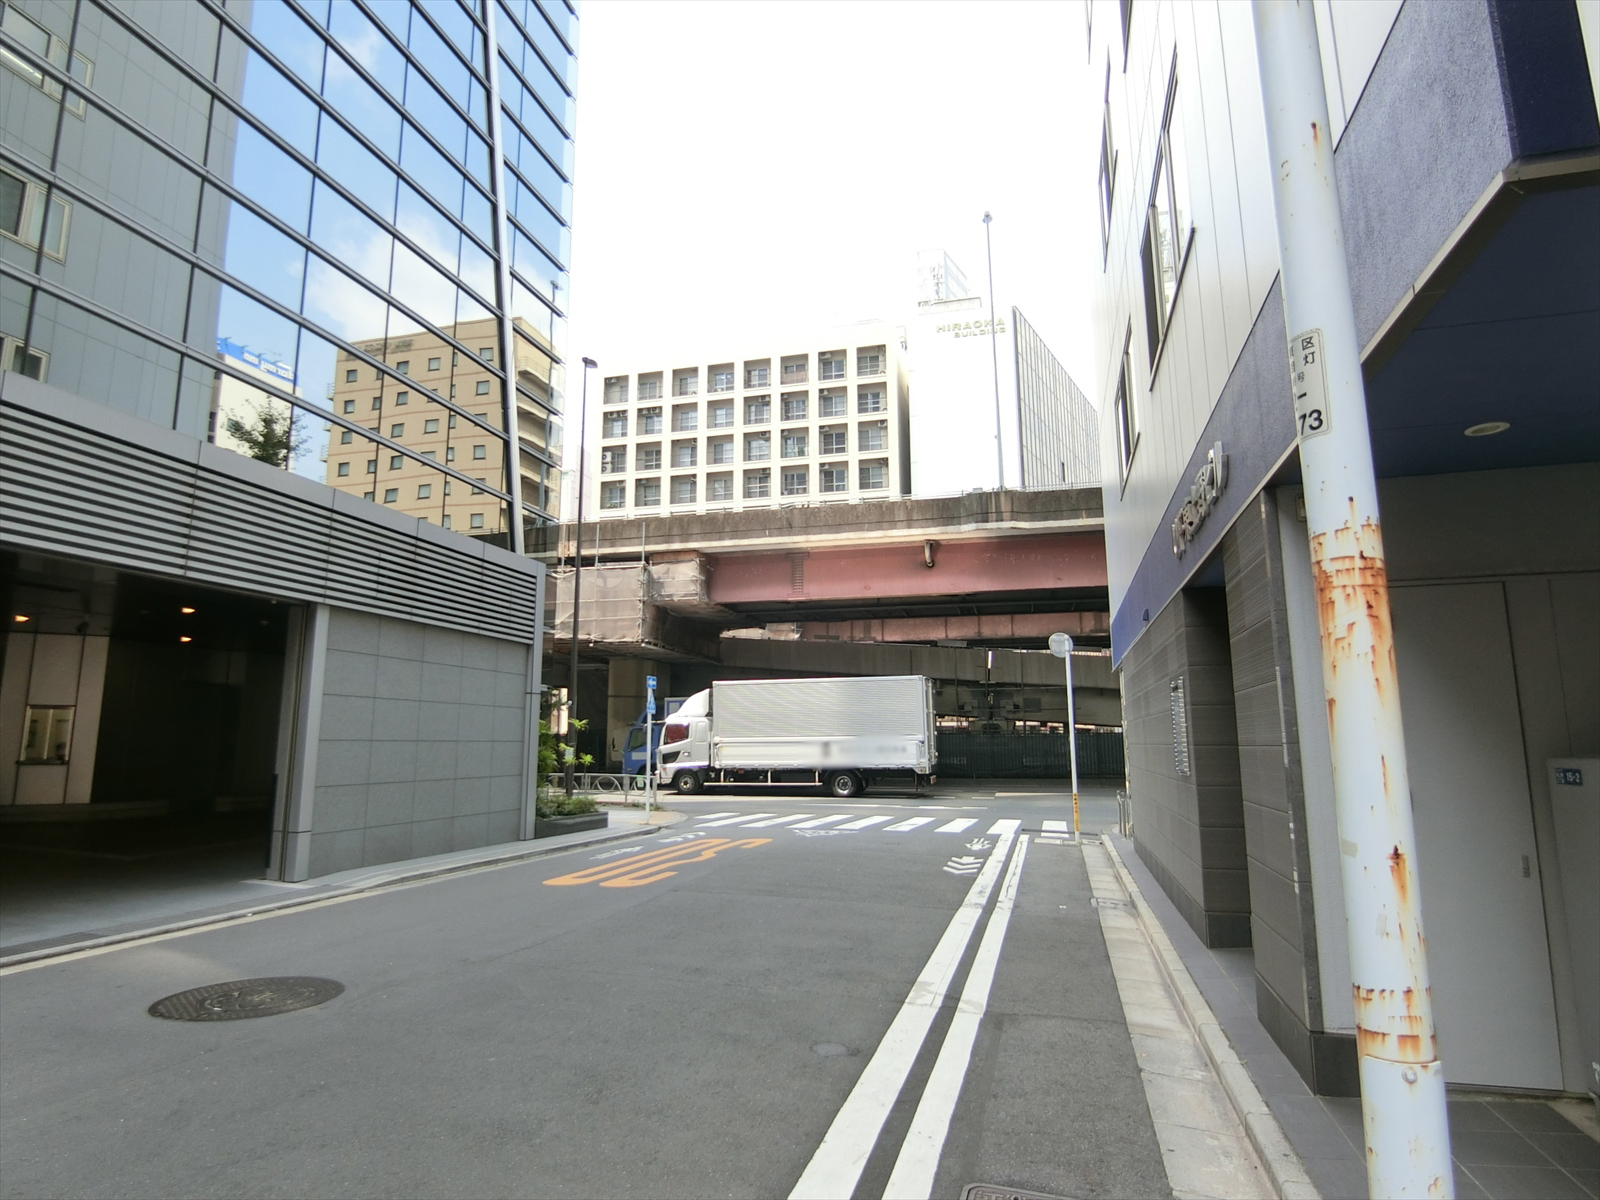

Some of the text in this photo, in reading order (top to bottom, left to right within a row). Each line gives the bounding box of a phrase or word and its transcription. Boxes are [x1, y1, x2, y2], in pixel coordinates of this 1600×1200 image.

[937, 318, 1005, 333] HIRAOKA
[954, 327, 1006, 338] BUILDING
[1301, 336, 1316, 366] 区灯
